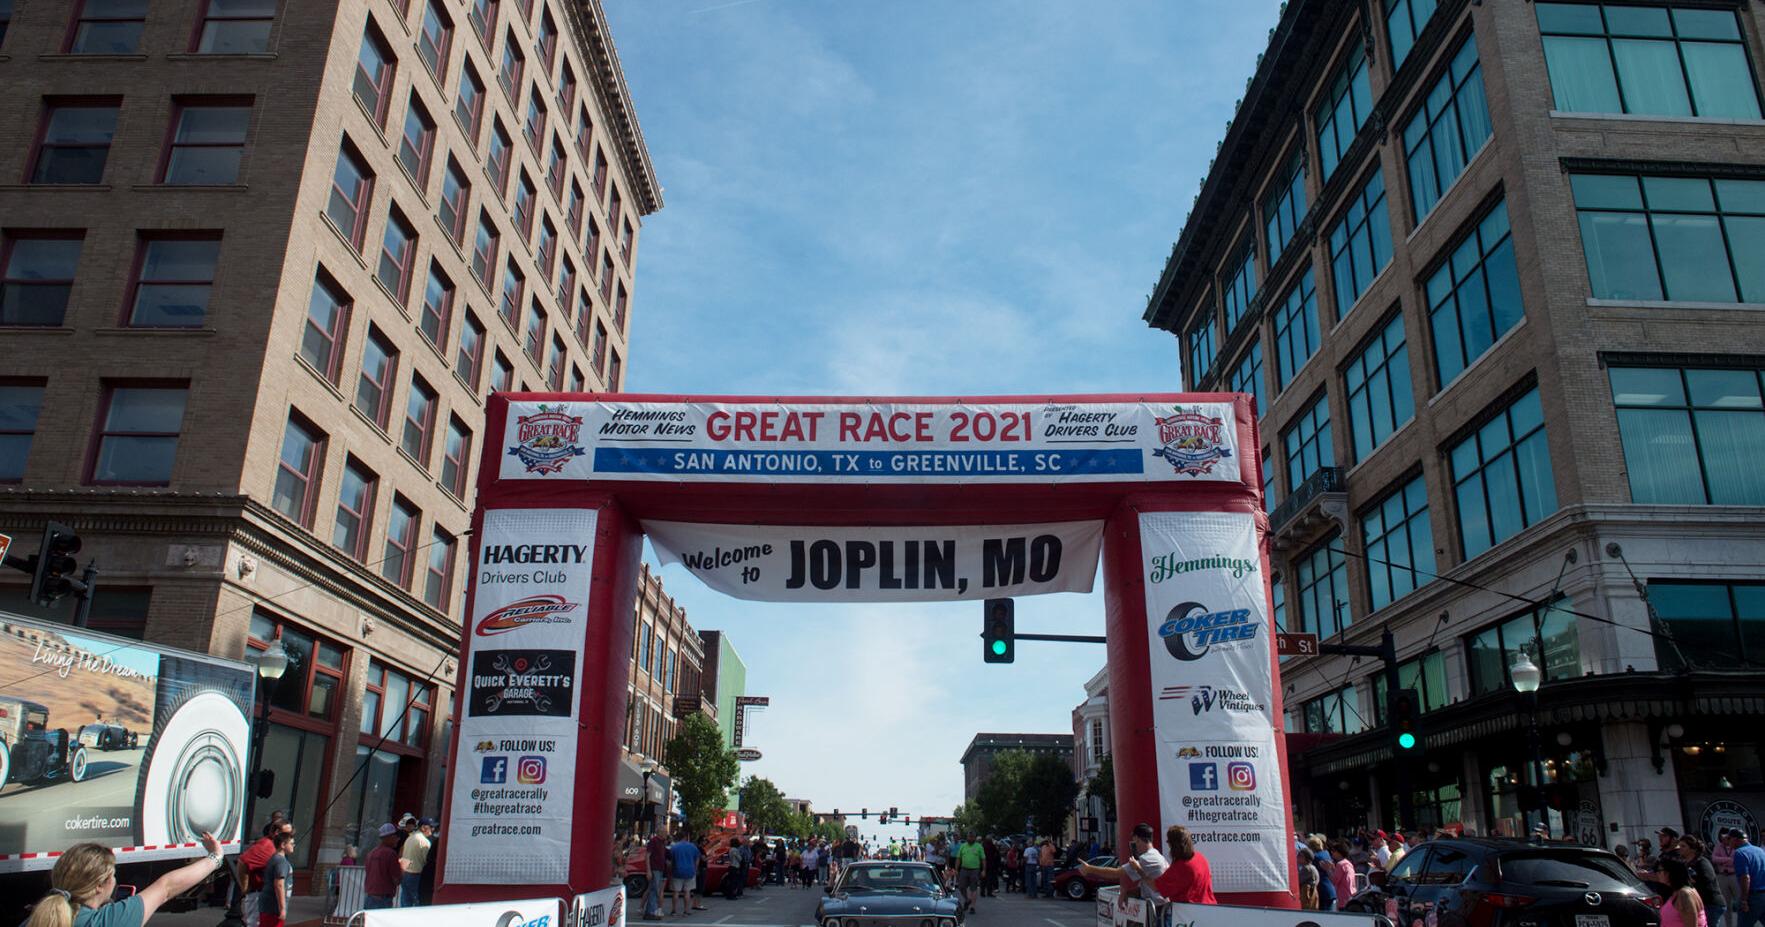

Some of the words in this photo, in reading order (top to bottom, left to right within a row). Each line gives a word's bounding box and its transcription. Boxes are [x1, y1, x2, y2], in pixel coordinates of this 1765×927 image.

[612, 409, 685, 422] HEMMINGS
[1058, 411, 1118, 424] HAGERTY
[518, 423, 552, 443] GREAT
[552, 423, 581, 443] RACE
[599, 423, 648, 435] MOTOR
[654, 423, 696, 435] NEWS
[706, 411, 825, 442] GREAT
[839, 411, 935, 442] RACE
[949, 411, 1032, 442] 2021
[1044, 424, 1099, 437] DRIVERS
[1104, 423, 1138, 437] CLUB
[1159, 424, 1193, 445] GREAT
[1193, 425, 1222, 445] RACE
[673, 453, 719, 471] SAN
[724, 452, 822, 473] ANTONIO,
[832, 454, 859, 472] TX
[868, 457, 883, 470] to
[891, 453, 1026, 473] GREENVILLE,
[1035, 453, 1062, 471] SC
[483, 544, 587, 564] HAGERTY
[681, 542, 773, 570] Welcome
[785, 539, 968, 595] JOPLIN,
[982, 534, 1063, 588] MO
[1151, 552, 1257, 584] Hemmings
[481, 571, 529, 584] Drivers
[533, 570, 567, 584] Club
[741, 564, 760, 585] to
[502, 604, 571, 618] RELIABLE
[1158, 608, 1250, 638] COKER
[1195, 623, 1259, 648] TIRE
[1298, 640, 1313, 653] St
[32, 640, 74, 678] Living
[77, 650, 99, 673] The
[474, 675, 505, 688] QUICK
[508, 674, 571, 688] EVERETT'S
[503, 688, 535, 699] GARAGE
[1219, 689, 1249, 701] Wheel
[1219, 700, 1265, 713] Vintiques
[499, 740, 536, 752] FOLLOW
[539, 740, 555, 752] US!
[1205, 746, 1242, 758] FOLLOW
[1245, 746, 1259, 758] US!
[471, 788, 548, 801] @greatracerally
[625, 787, 639, 795] 609
[1182, 794, 1261, 808] @greatracerally
[473, 803, 542, 816] #thegreatrace
[1188, 809, 1258, 823] #thegreatrace
[65, 815, 130, 830] cokertire.com
[1717, 816, 1741, 825] ROUTE
[472, 824, 542, 837] greatrace.com
[1191, 831, 1261, 844] greatrace.com
[1582, 828, 1597, 846] 66
